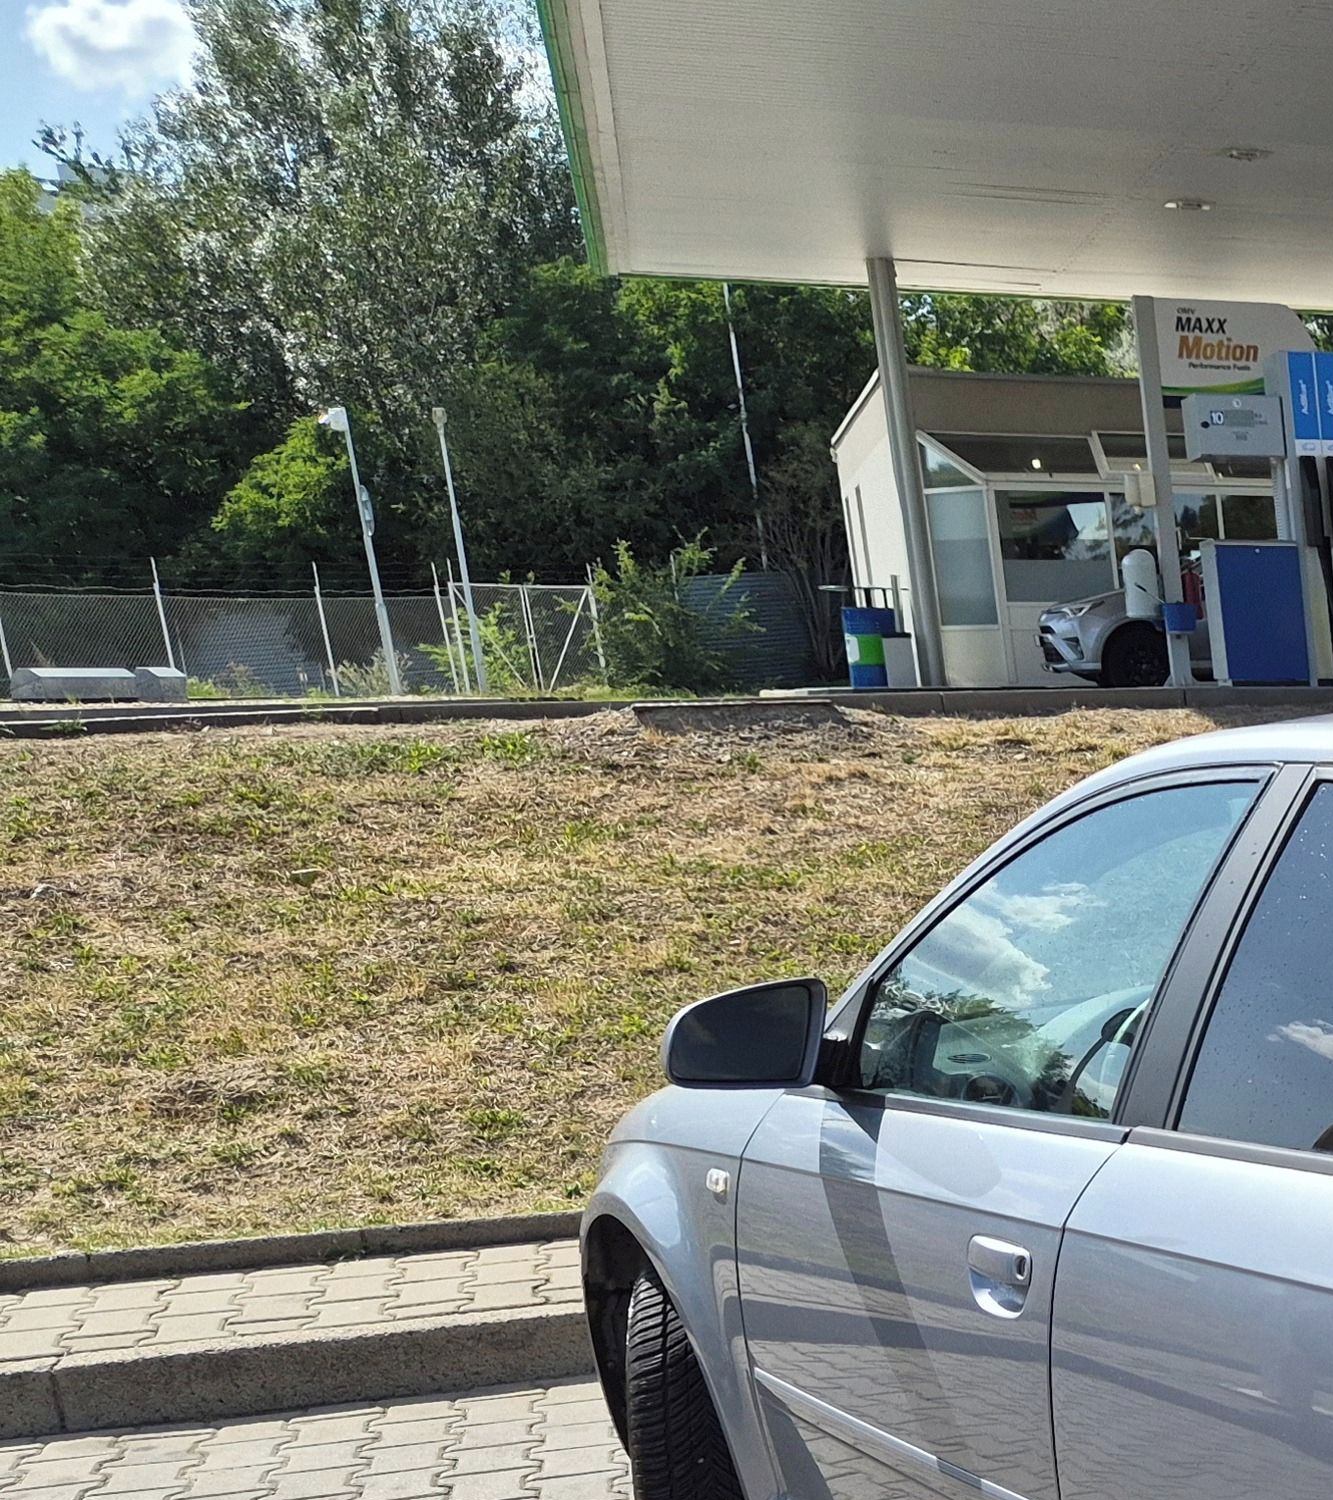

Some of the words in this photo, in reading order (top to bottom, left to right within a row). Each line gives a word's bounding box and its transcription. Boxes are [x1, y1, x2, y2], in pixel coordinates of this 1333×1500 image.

[1175, 316, 1228, 335] MAXX
[1177, 335, 1260, 363] Motion
[1211, 411, 1224, 425] 10
